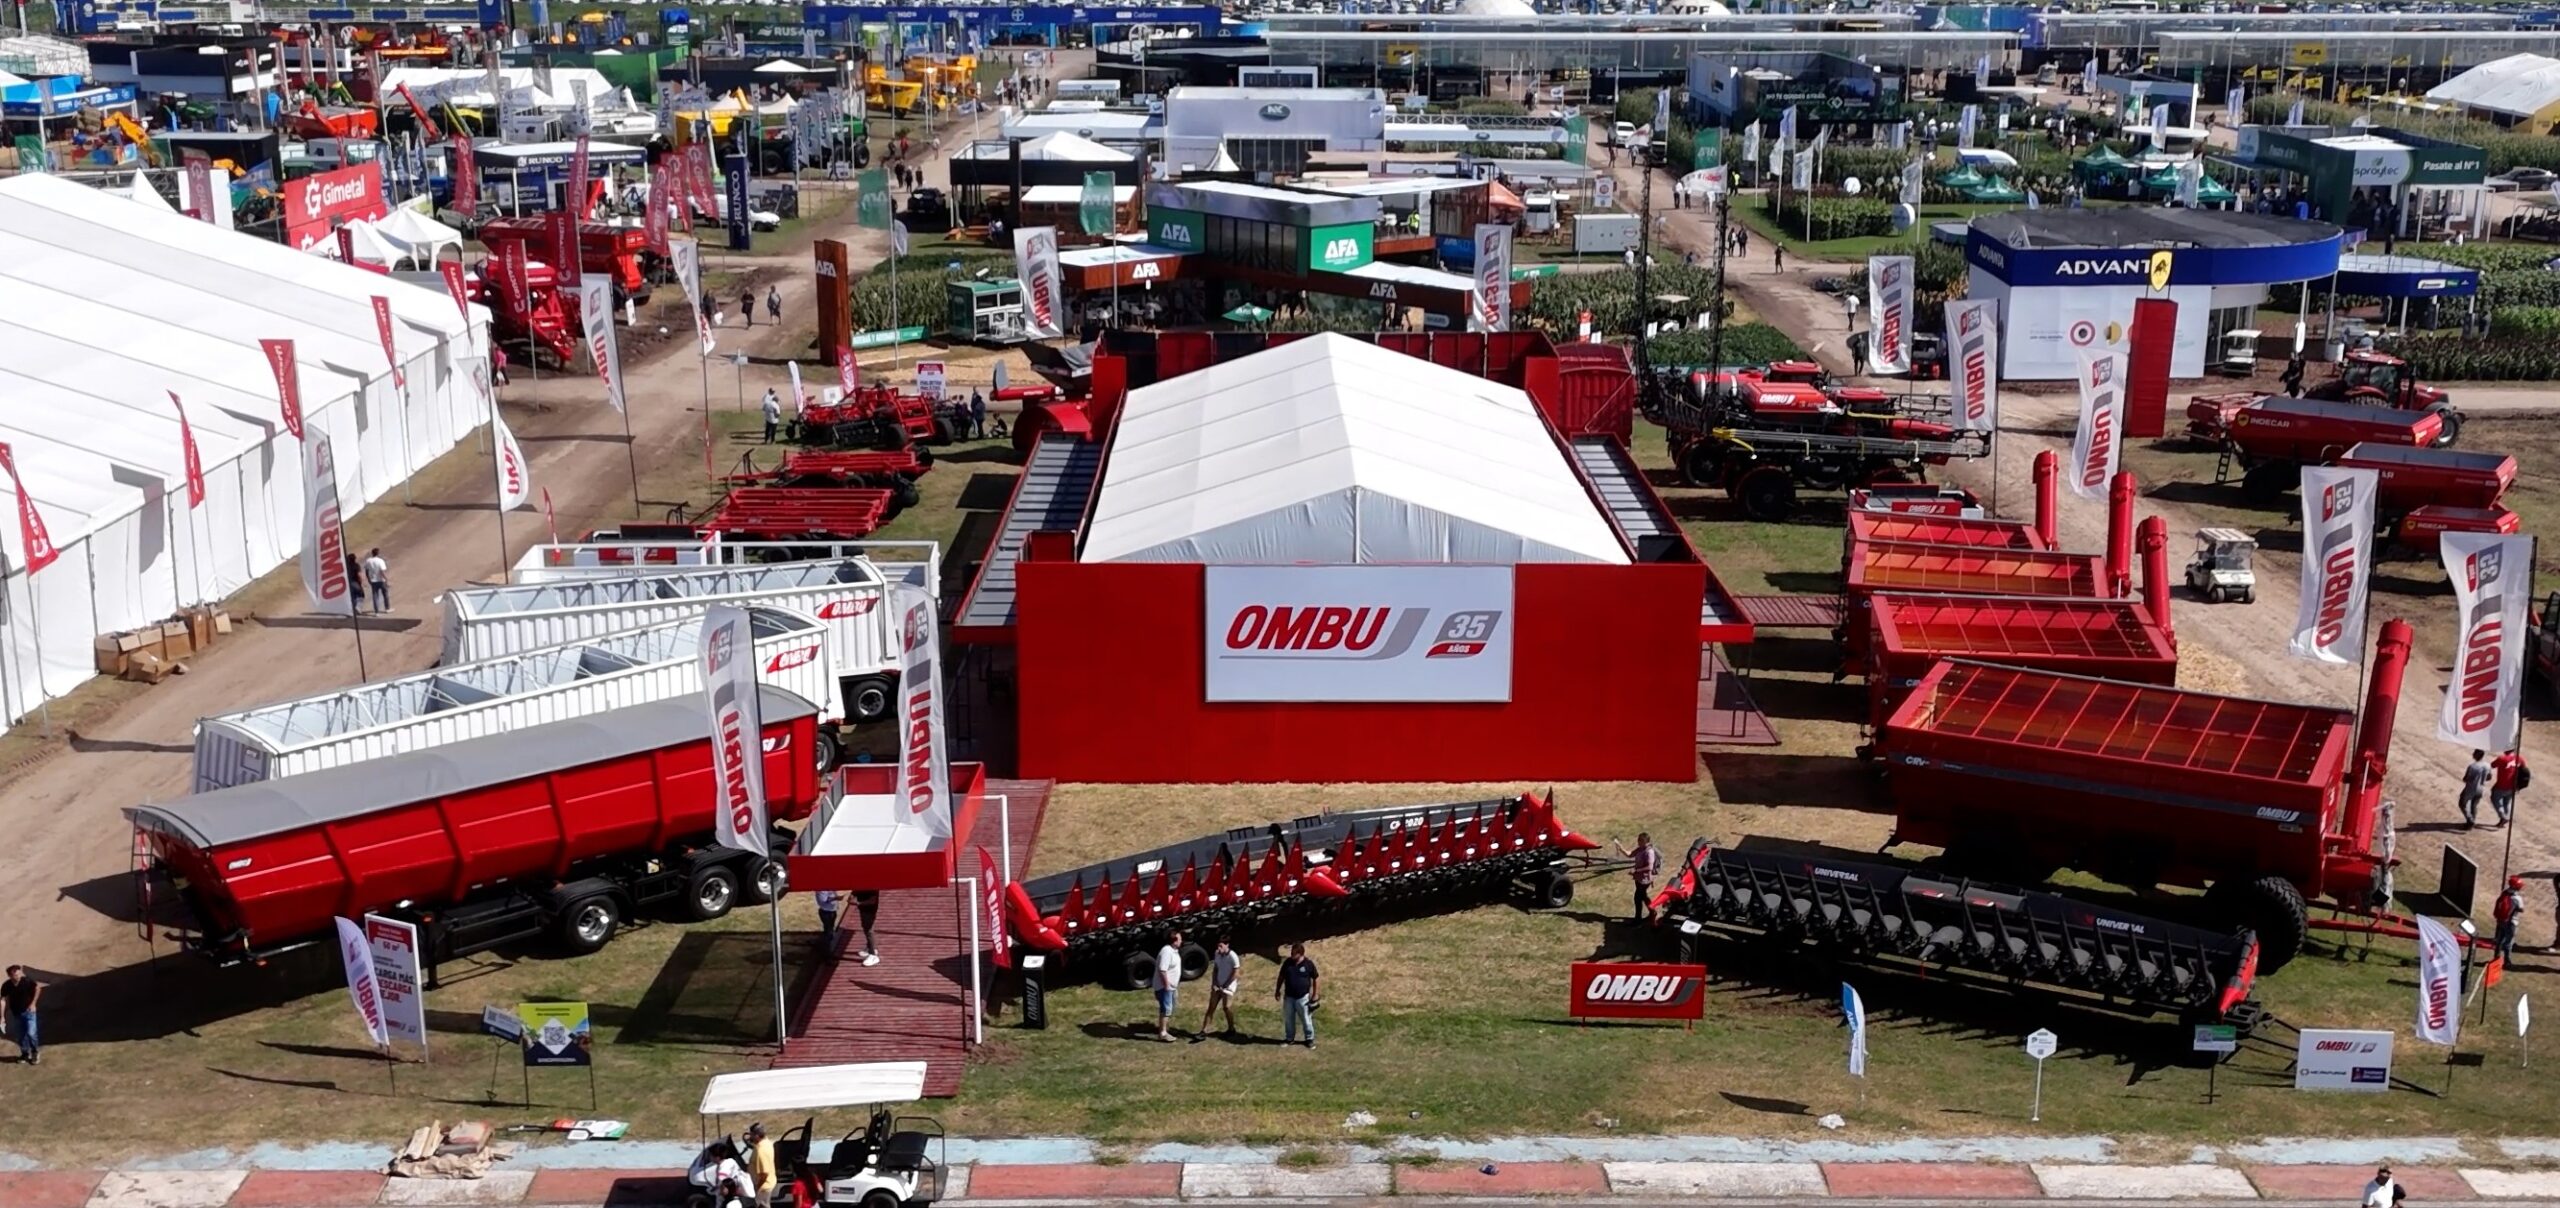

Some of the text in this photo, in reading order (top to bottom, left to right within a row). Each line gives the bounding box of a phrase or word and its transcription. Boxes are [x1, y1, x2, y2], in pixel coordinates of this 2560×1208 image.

[1672, 5, 1710, 15] YPF
[528, 156, 563, 164] RUNCO
[2423, 161, 2450, 170] Pasate
[2353, 166, 2399, 178] spraytec
[323, 174, 365, 206] Gimetal
[1161, 223, 1191, 243] AFA
[1325, 238, 1359, 257] AFA
[815, 260, 837, 278] AFA
[1133, 263, 1160, 279] AFA
[2055, 260, 2152, 275] ADVANT
[1369, 282, 1397, 299] AFA
[1760, 394, 1789, 404] OMBU
[2250, 416, 2290, 428] INDECAR
[1226, 605, 1489, 651] OMBU 35
[1447, 643, 1470, 654] AÑOS
[2257, 807, 2291, 820] OMBU
[1814, 867, 1859, 881] UNIVERSAL
[1586, 974, 1681, 1003] OMBU
[2316, 1041, 2353, 1051] OMBU
